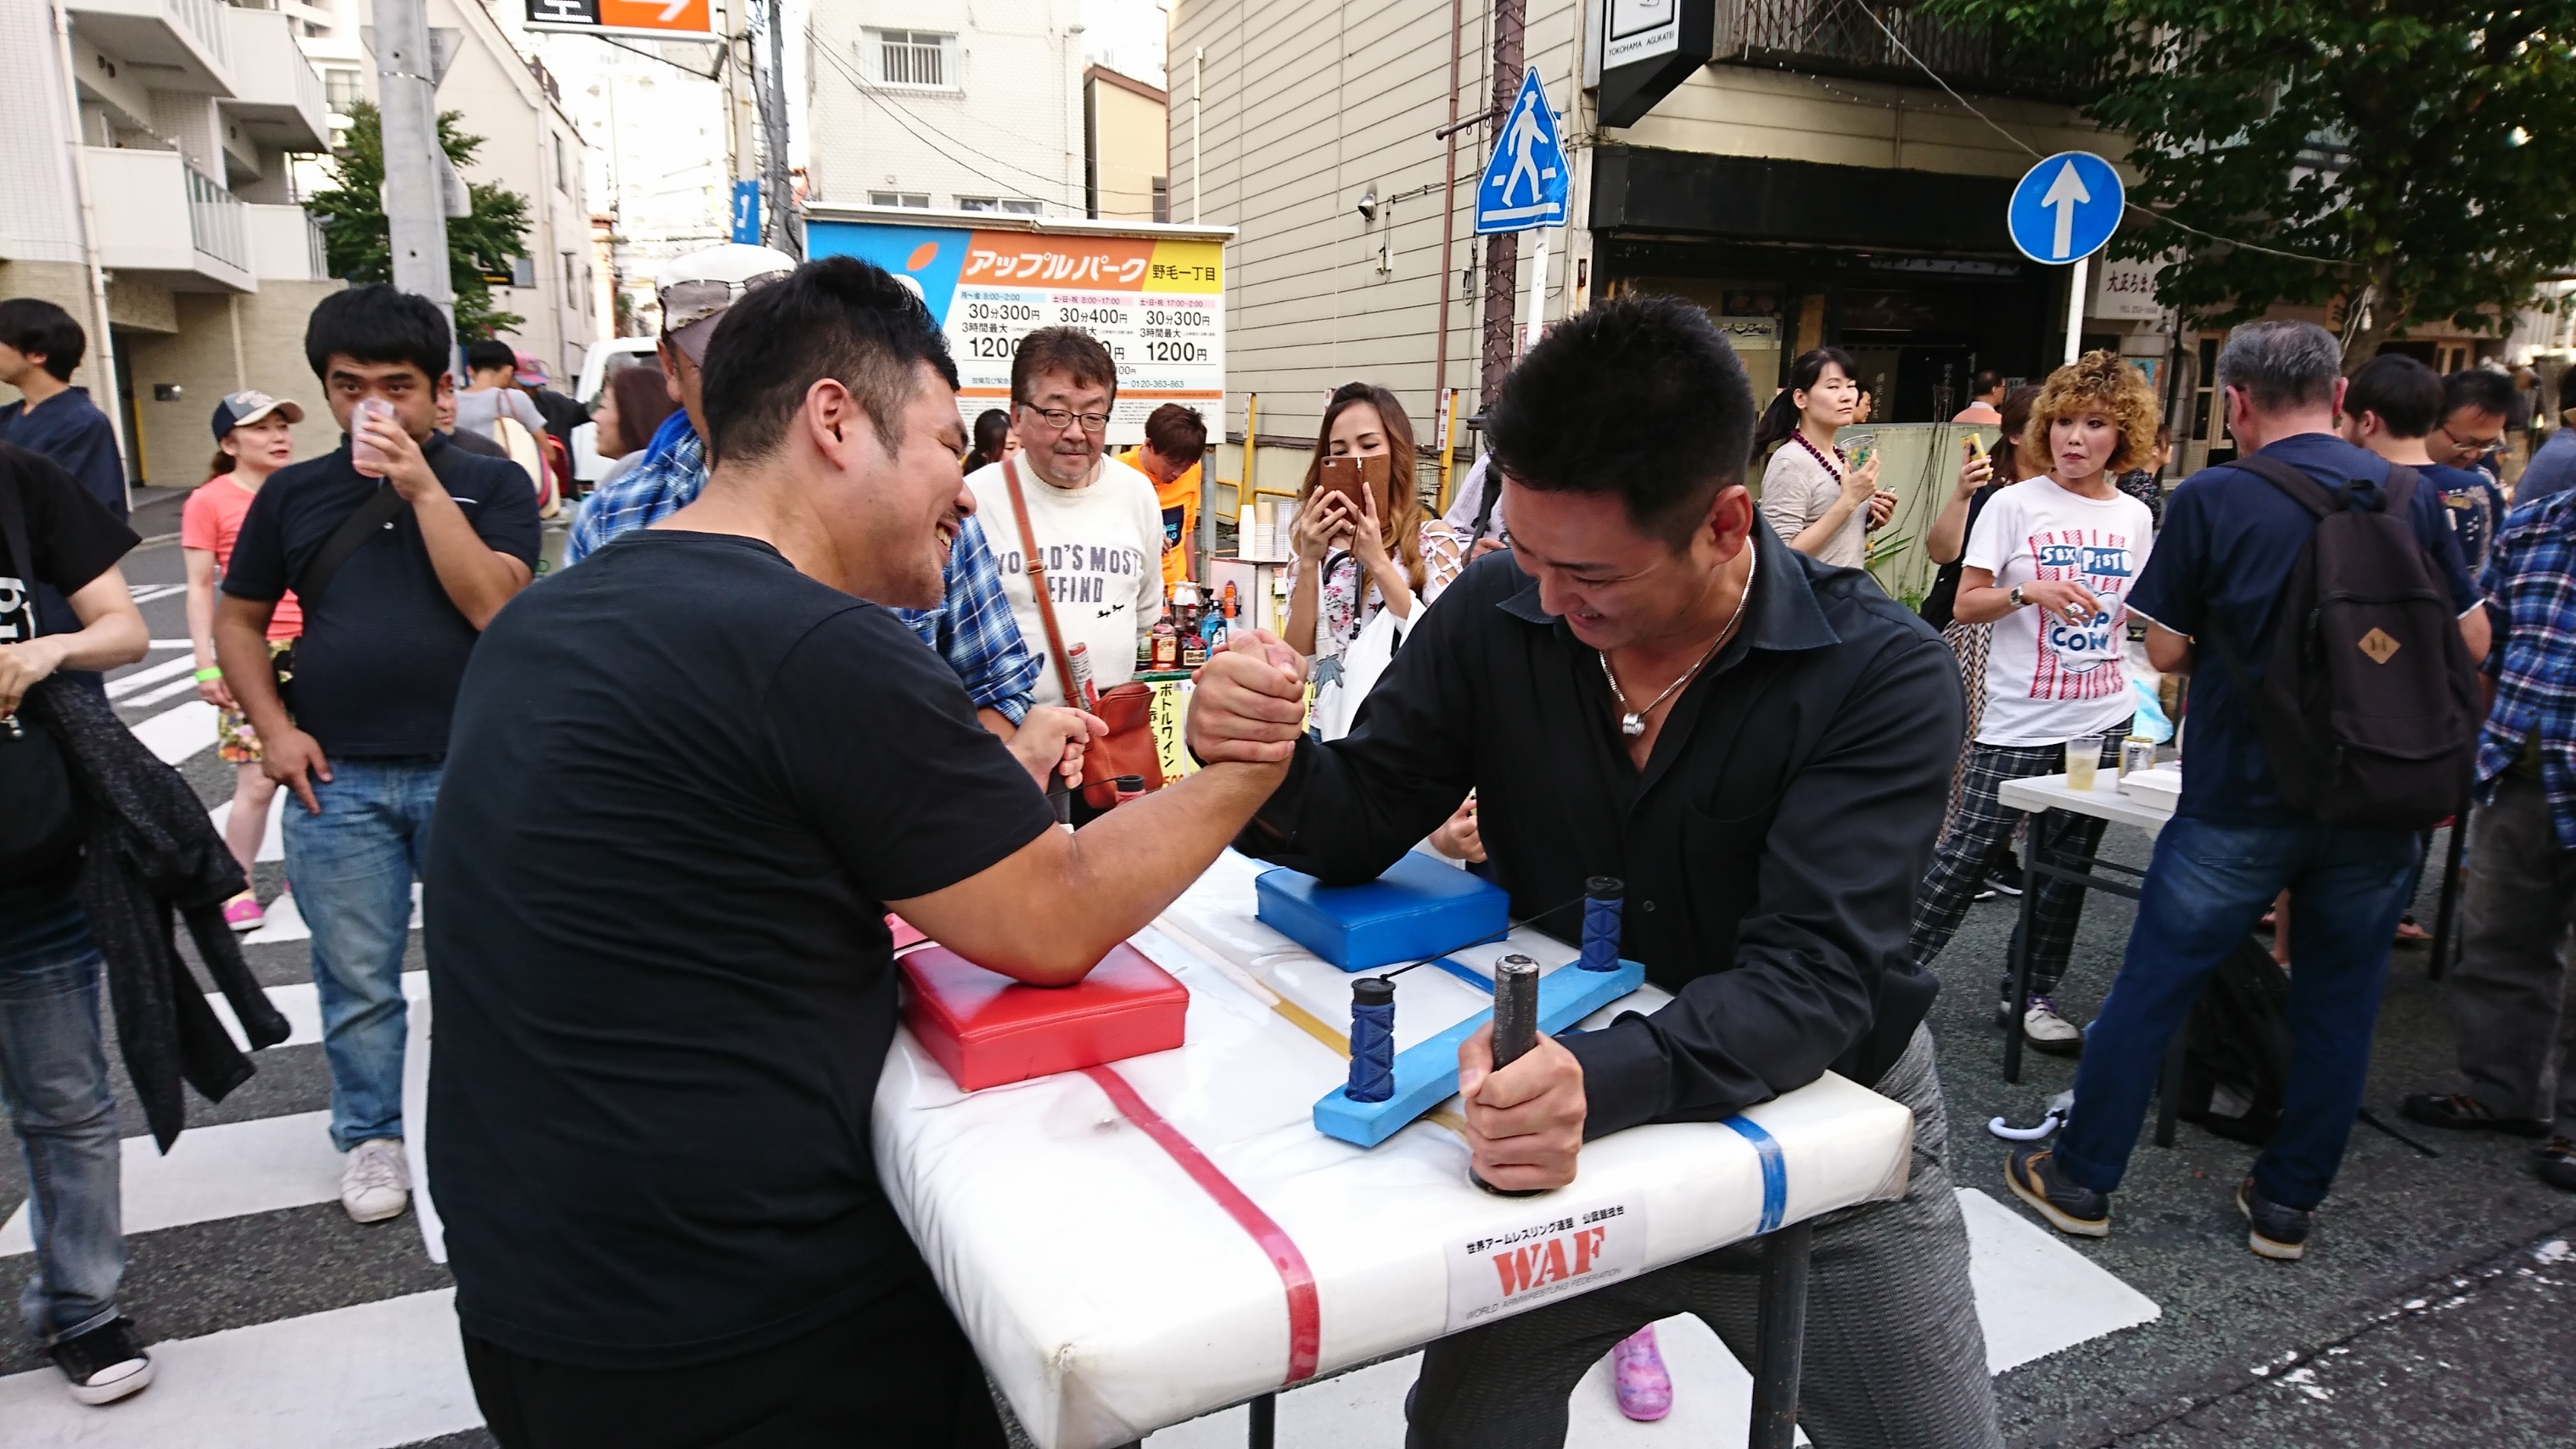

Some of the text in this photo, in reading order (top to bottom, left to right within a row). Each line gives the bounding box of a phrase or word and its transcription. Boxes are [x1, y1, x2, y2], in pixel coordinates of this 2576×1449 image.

[1609, 31, 1674, 56] YOKOHAMA AGURATEI
[966, 250, 1146, 283] アップルパーク
[1152, 265, 1216, 281] 野毛一丁目
[968, 303, 1040, 321] 30分300円
[1060, 307, 1128, 324] 30分400円
[1145, 310, 1210, 326] 30分300円
[961, 322, 1008, 333] 3時間最大
[1140, 328, 1181, 338] 3時間最大
[969, 337, 1019, 357] 1200
[1145, 342, 1207, 361] 1200円
[1089, 547, 1140, 577] MOST
[1033, 576, 1104, 602] EFIND
[1160, 683, 1174, 768] ボトルワイン
[1466, 1217, 1575, 1255] 世界アームレスリング連盟
[1492, 1226, 1605, 1296] WAF
[1466, 1267, 1622, 1320] WORLD ARMWRESTLING FEDERATION
